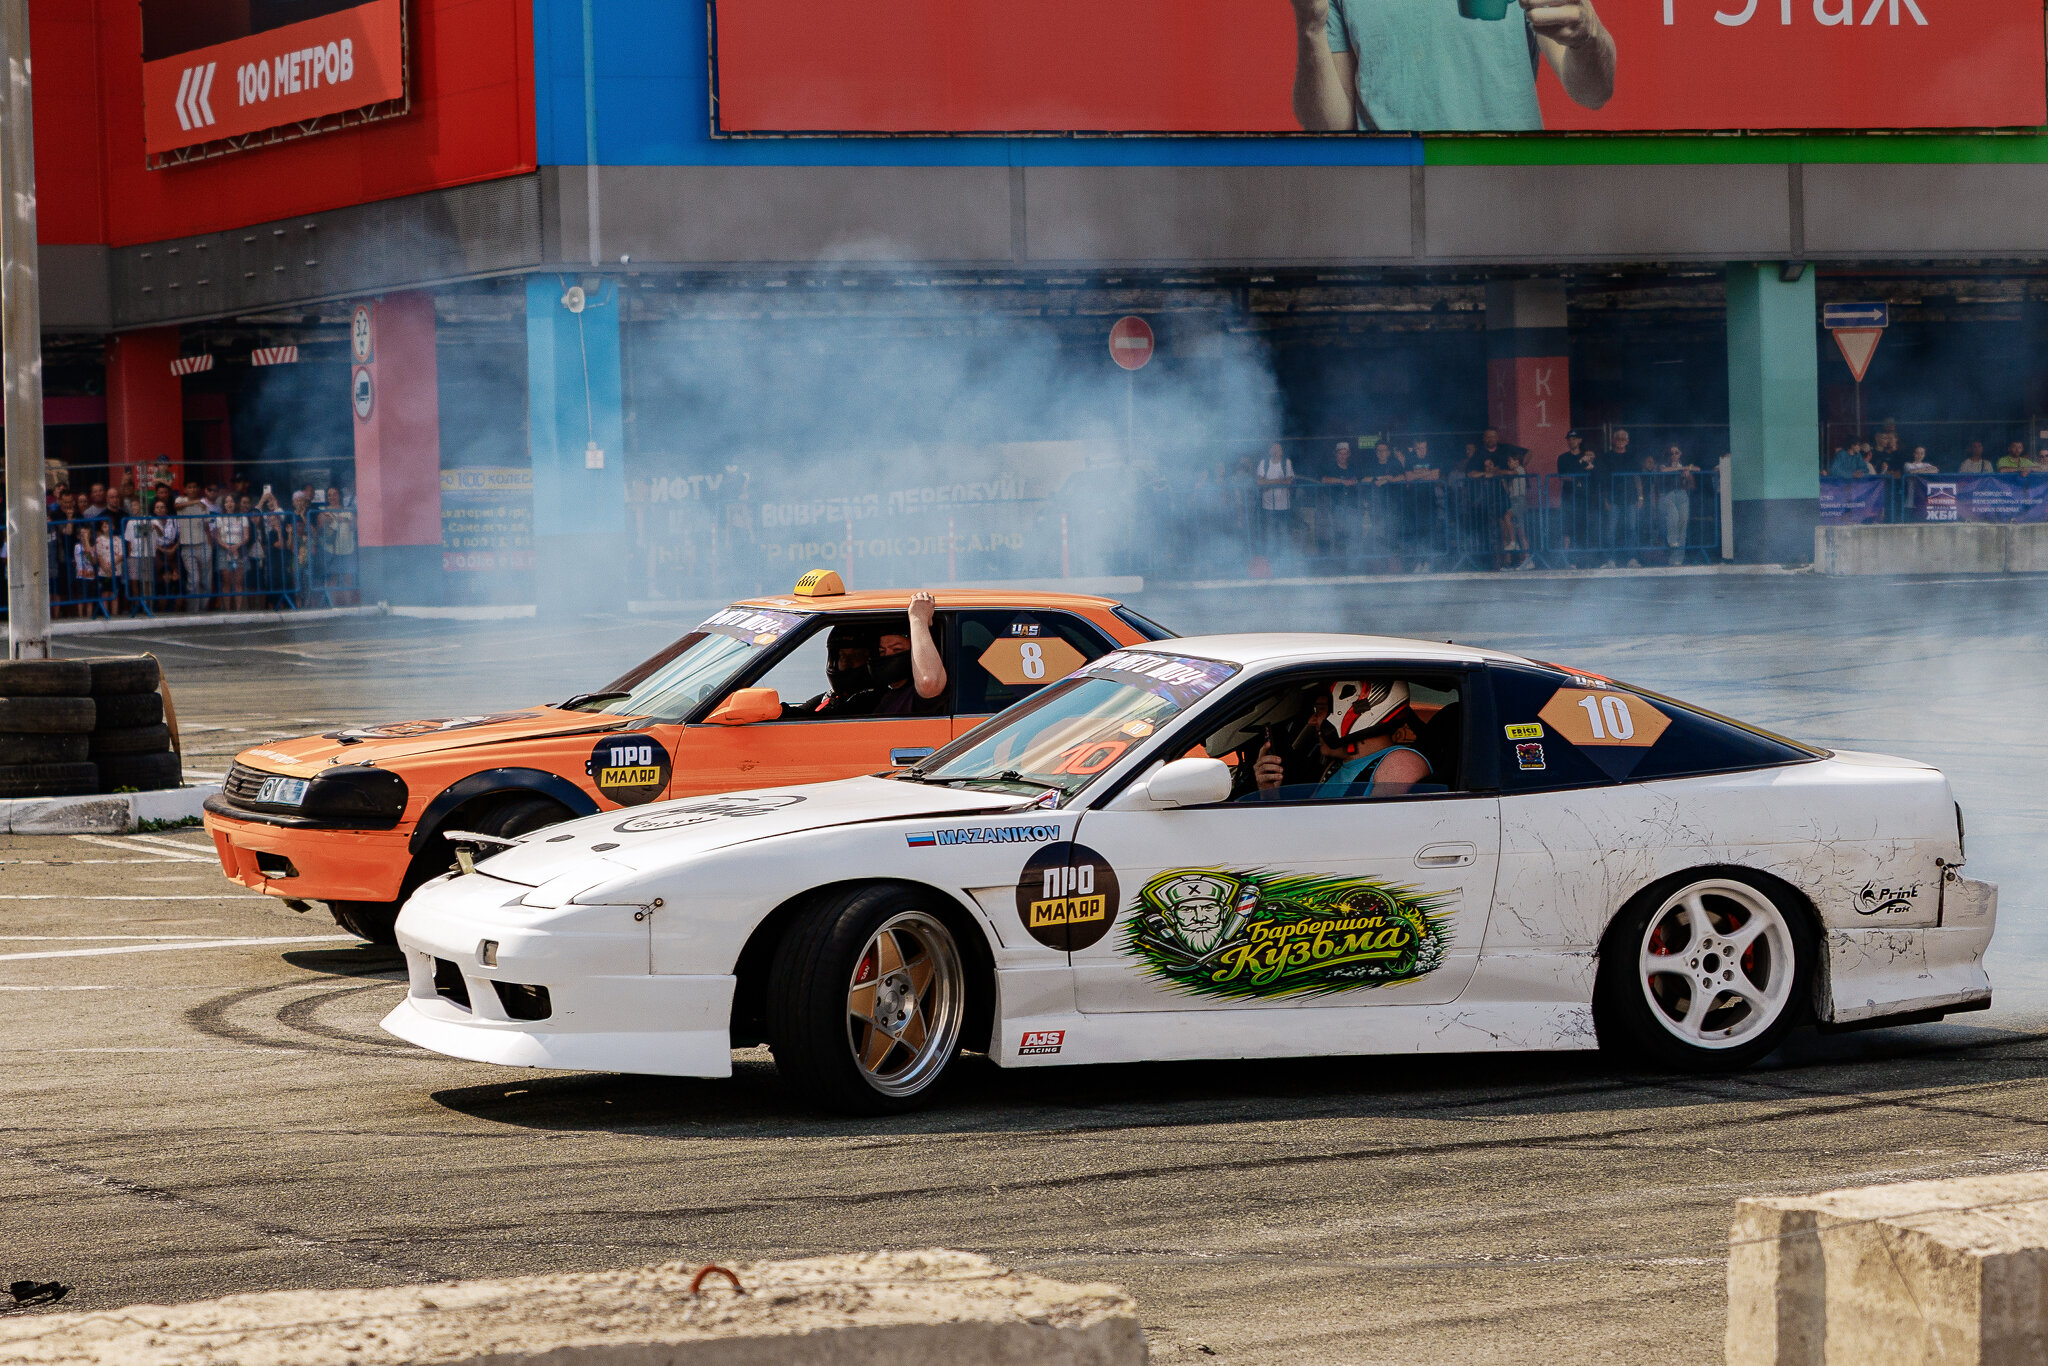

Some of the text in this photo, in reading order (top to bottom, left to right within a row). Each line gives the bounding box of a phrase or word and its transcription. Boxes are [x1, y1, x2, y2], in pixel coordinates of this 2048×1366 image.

[236, 38, 355, 107] 100 МЕТРОВ
[1536, 399, 1551, 428] 1
[1927, 510, 1957, 520] ЖБИ
[1012, 624, 1039, 636] UAS
[1020, 642, 1045, 679] 8
[1144, 662, 1207, 686] ШОУ
[1575, 676, 1606, 689] UAS
[1127, 723, 1147, 735] 10
[1578, 695, 1634, 740] 10
[610, 745, 652, 767] ПРО
[1051, 740, 1128, 775] 10
[605, 769, 656, 784] МАЛЯР
[937, 825, 1061, 846] MAZANIKOV
[1042, 864, 1094, 899] ПРО
[1879, 886, 1918, 900] Print
[1035, 899, 1100, 923] МАЛЯР
[1886, 904, 1911, 915] Fox
[1246, 914, 1387, 947] Барбершоп
[1211, 926, 1411, 986] Кузьма
[1025, 1032, 1060, 1046] AJS
